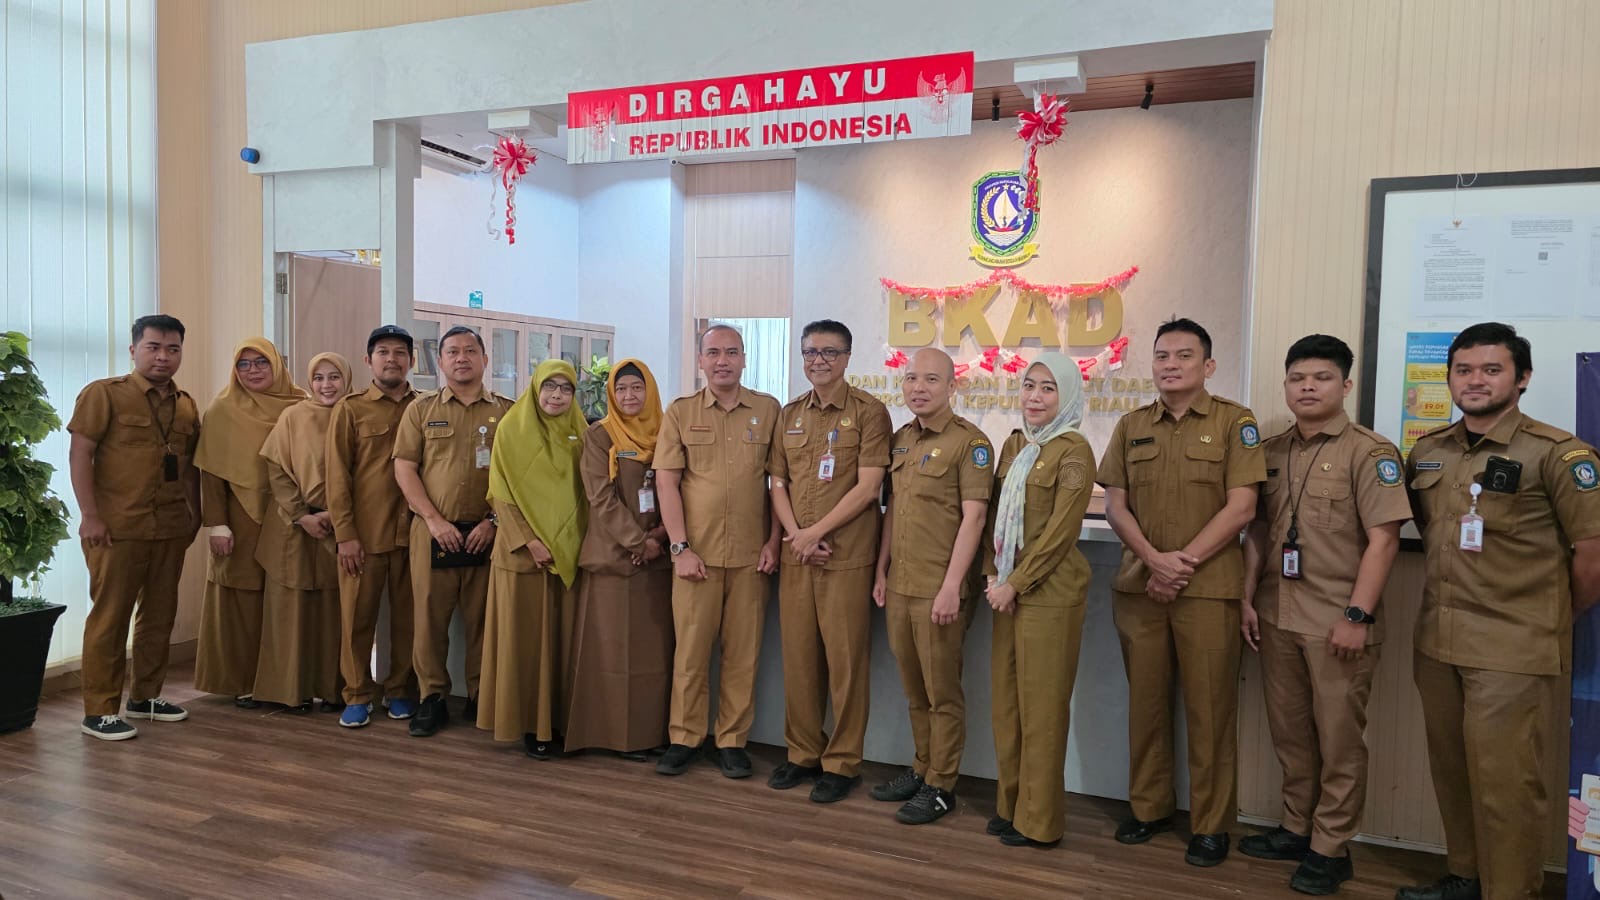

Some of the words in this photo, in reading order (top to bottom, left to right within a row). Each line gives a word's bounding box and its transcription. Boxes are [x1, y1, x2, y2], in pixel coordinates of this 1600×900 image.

[628, 67, 887, 118] DIRGAHAYU
[629, 126, 751, 155] REPUBLIK
[762, 112, 912, 146] INDONESIA
[888, 283, 1124, 347] BKAD
[848, 374, 887, 389] DAN
[1089, 396, 1139, 412] RIAU
